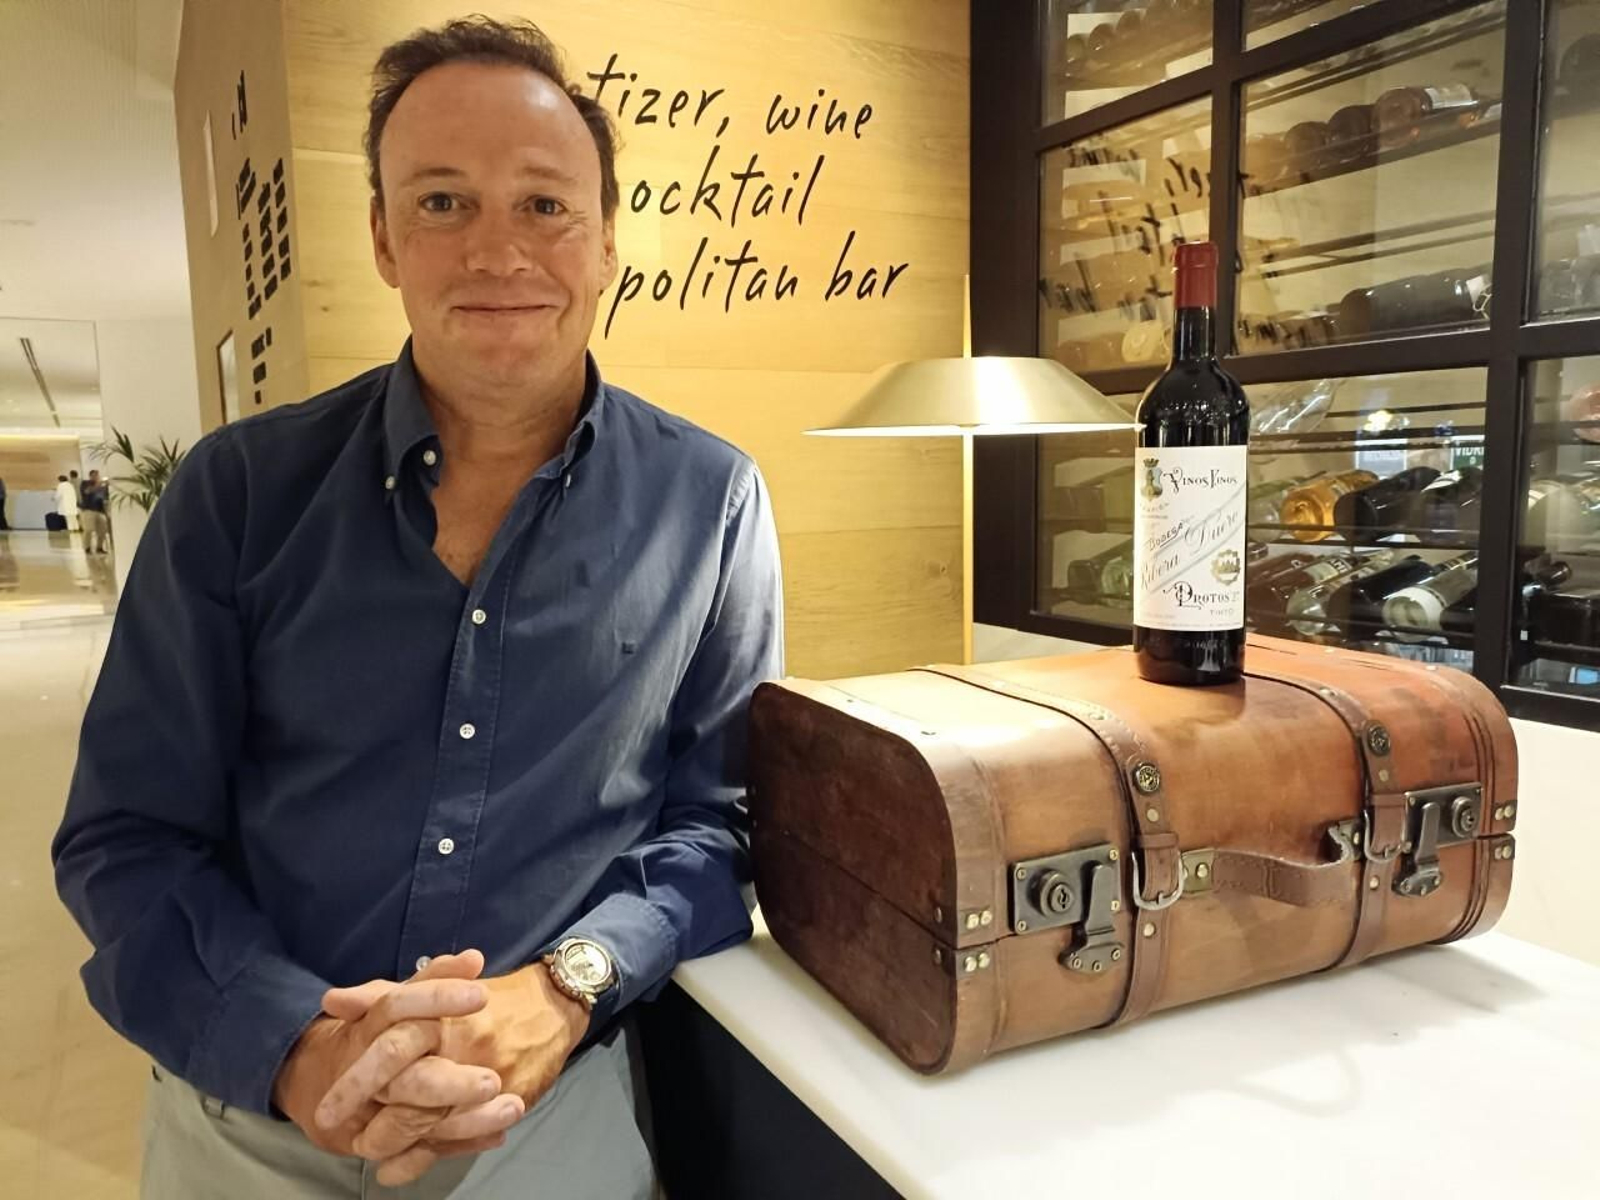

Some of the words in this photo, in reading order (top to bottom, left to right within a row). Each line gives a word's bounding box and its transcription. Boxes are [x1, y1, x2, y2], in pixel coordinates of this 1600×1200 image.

[586, 53, 730, 138] tizer,
[766, 88, 874, 139] wine
[630, 144, 825, 228] ocktail
[603, 236, 799, 340] politan
[824, 230, 910, 302] bar
[1453, 446, 1485, 457] VIDRI
